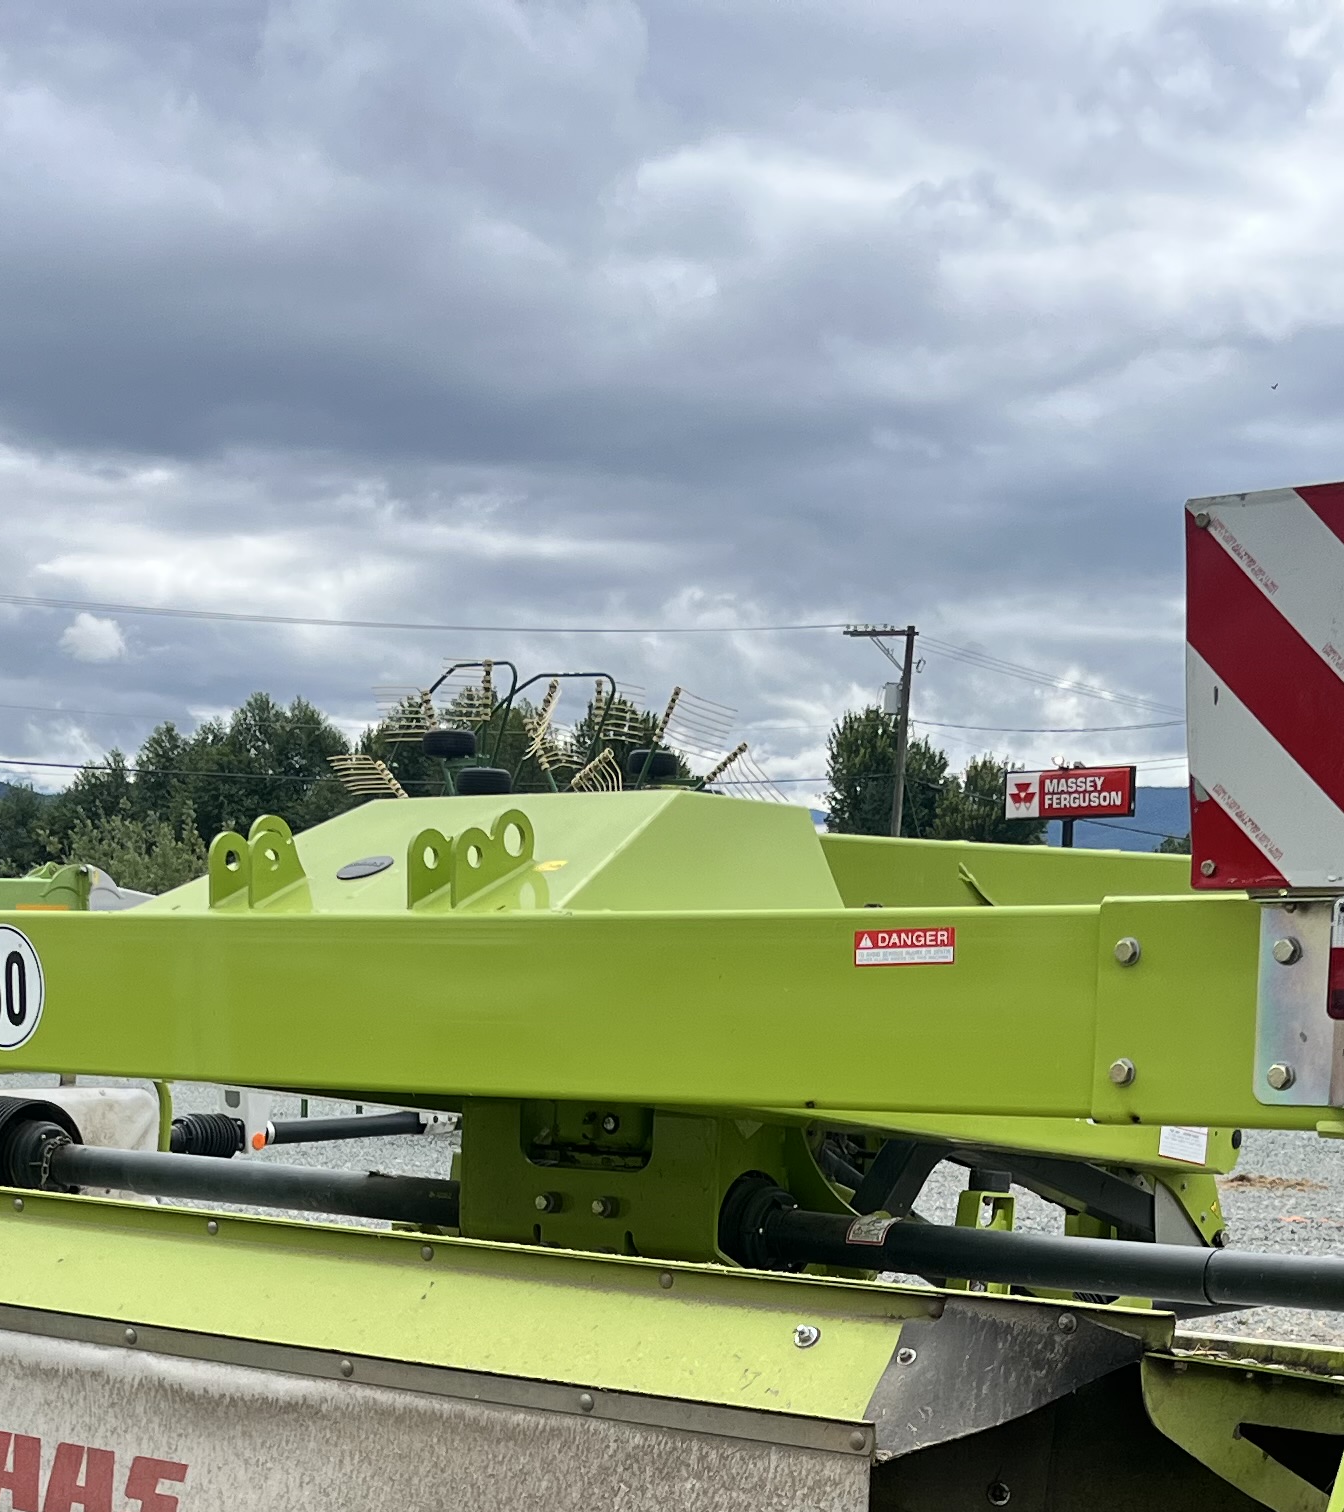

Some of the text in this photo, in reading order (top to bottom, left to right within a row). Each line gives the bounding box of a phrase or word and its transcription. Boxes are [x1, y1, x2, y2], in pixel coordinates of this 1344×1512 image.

[1044, 776, 1105, 793] MASSEY
[1044, 791, 1122, 809] FERGUSON
[877, 930, 949, 947] DANGER
